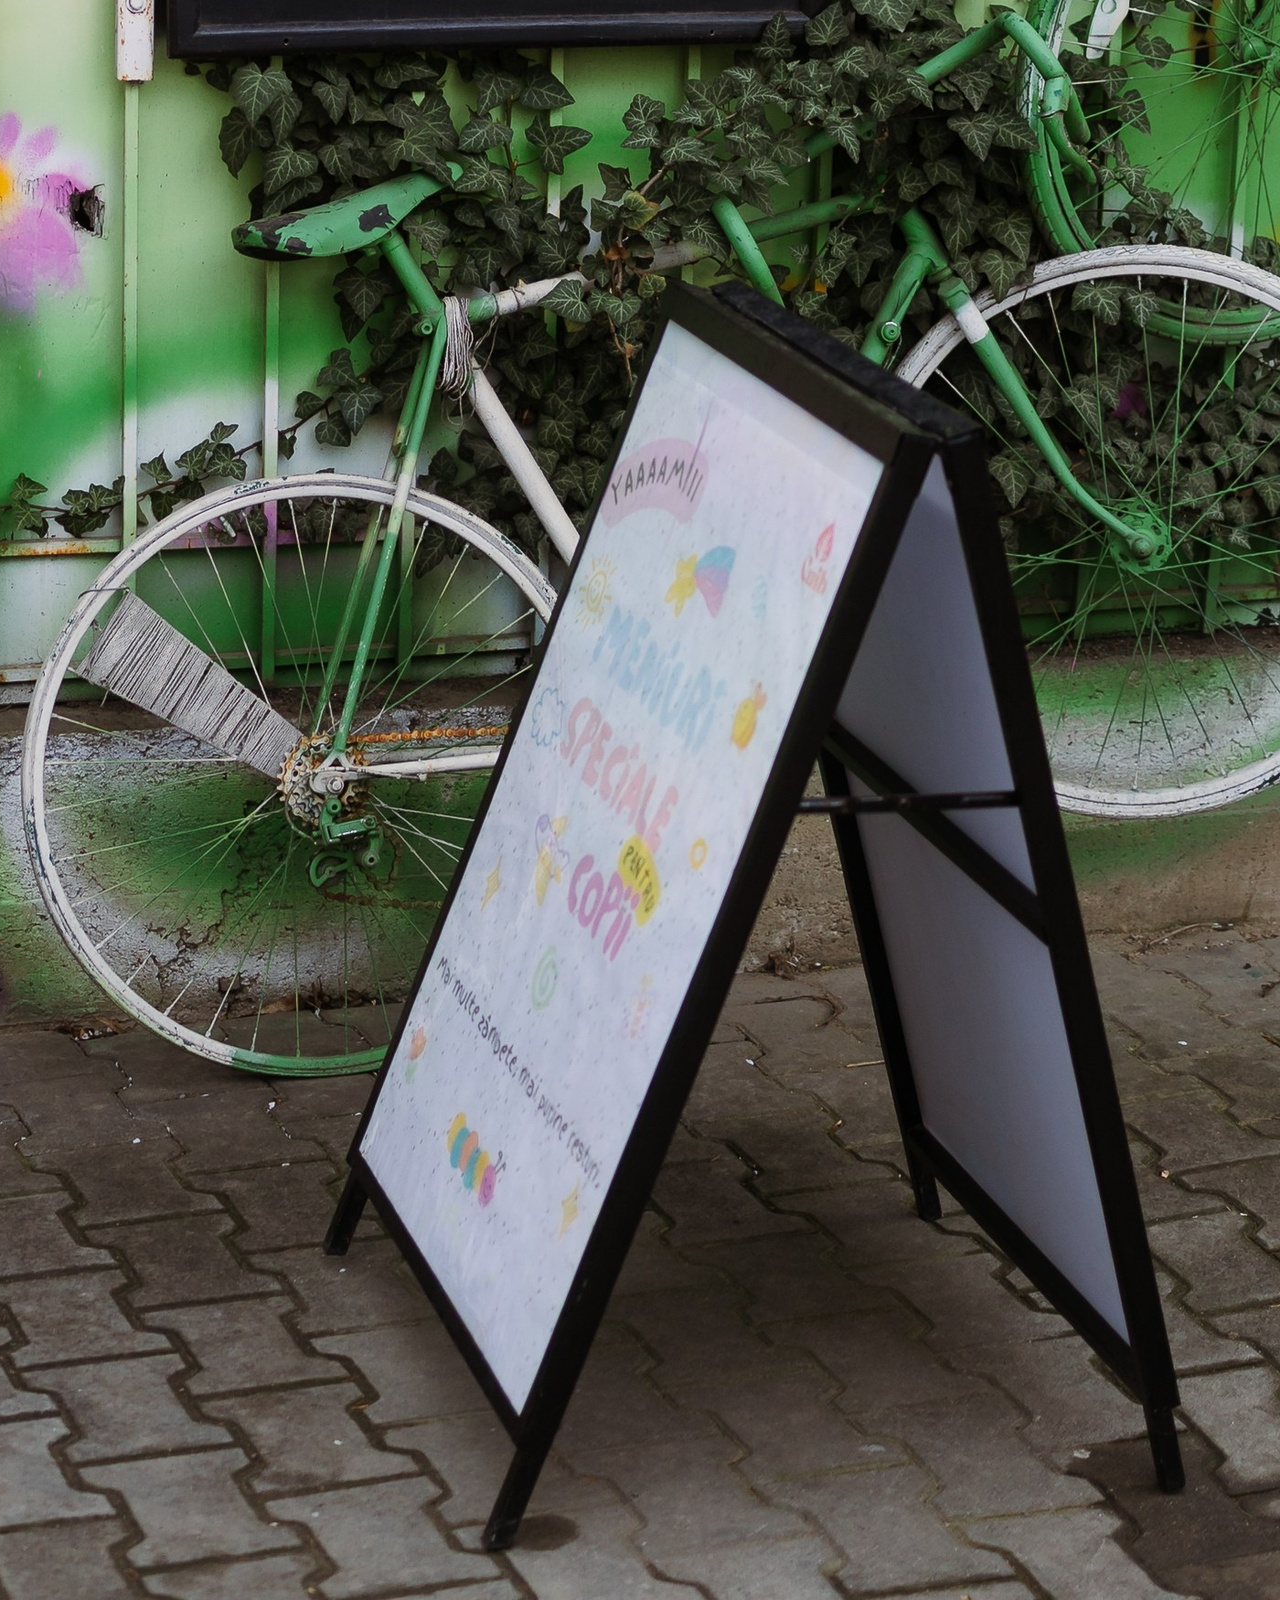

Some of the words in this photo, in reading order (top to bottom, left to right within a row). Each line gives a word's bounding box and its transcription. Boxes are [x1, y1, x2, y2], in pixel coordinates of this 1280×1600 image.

[435, 956, 457, 985] Mai
[451, 978, 481, 1023] multe
[519, 1067, 543, 1100] mai
